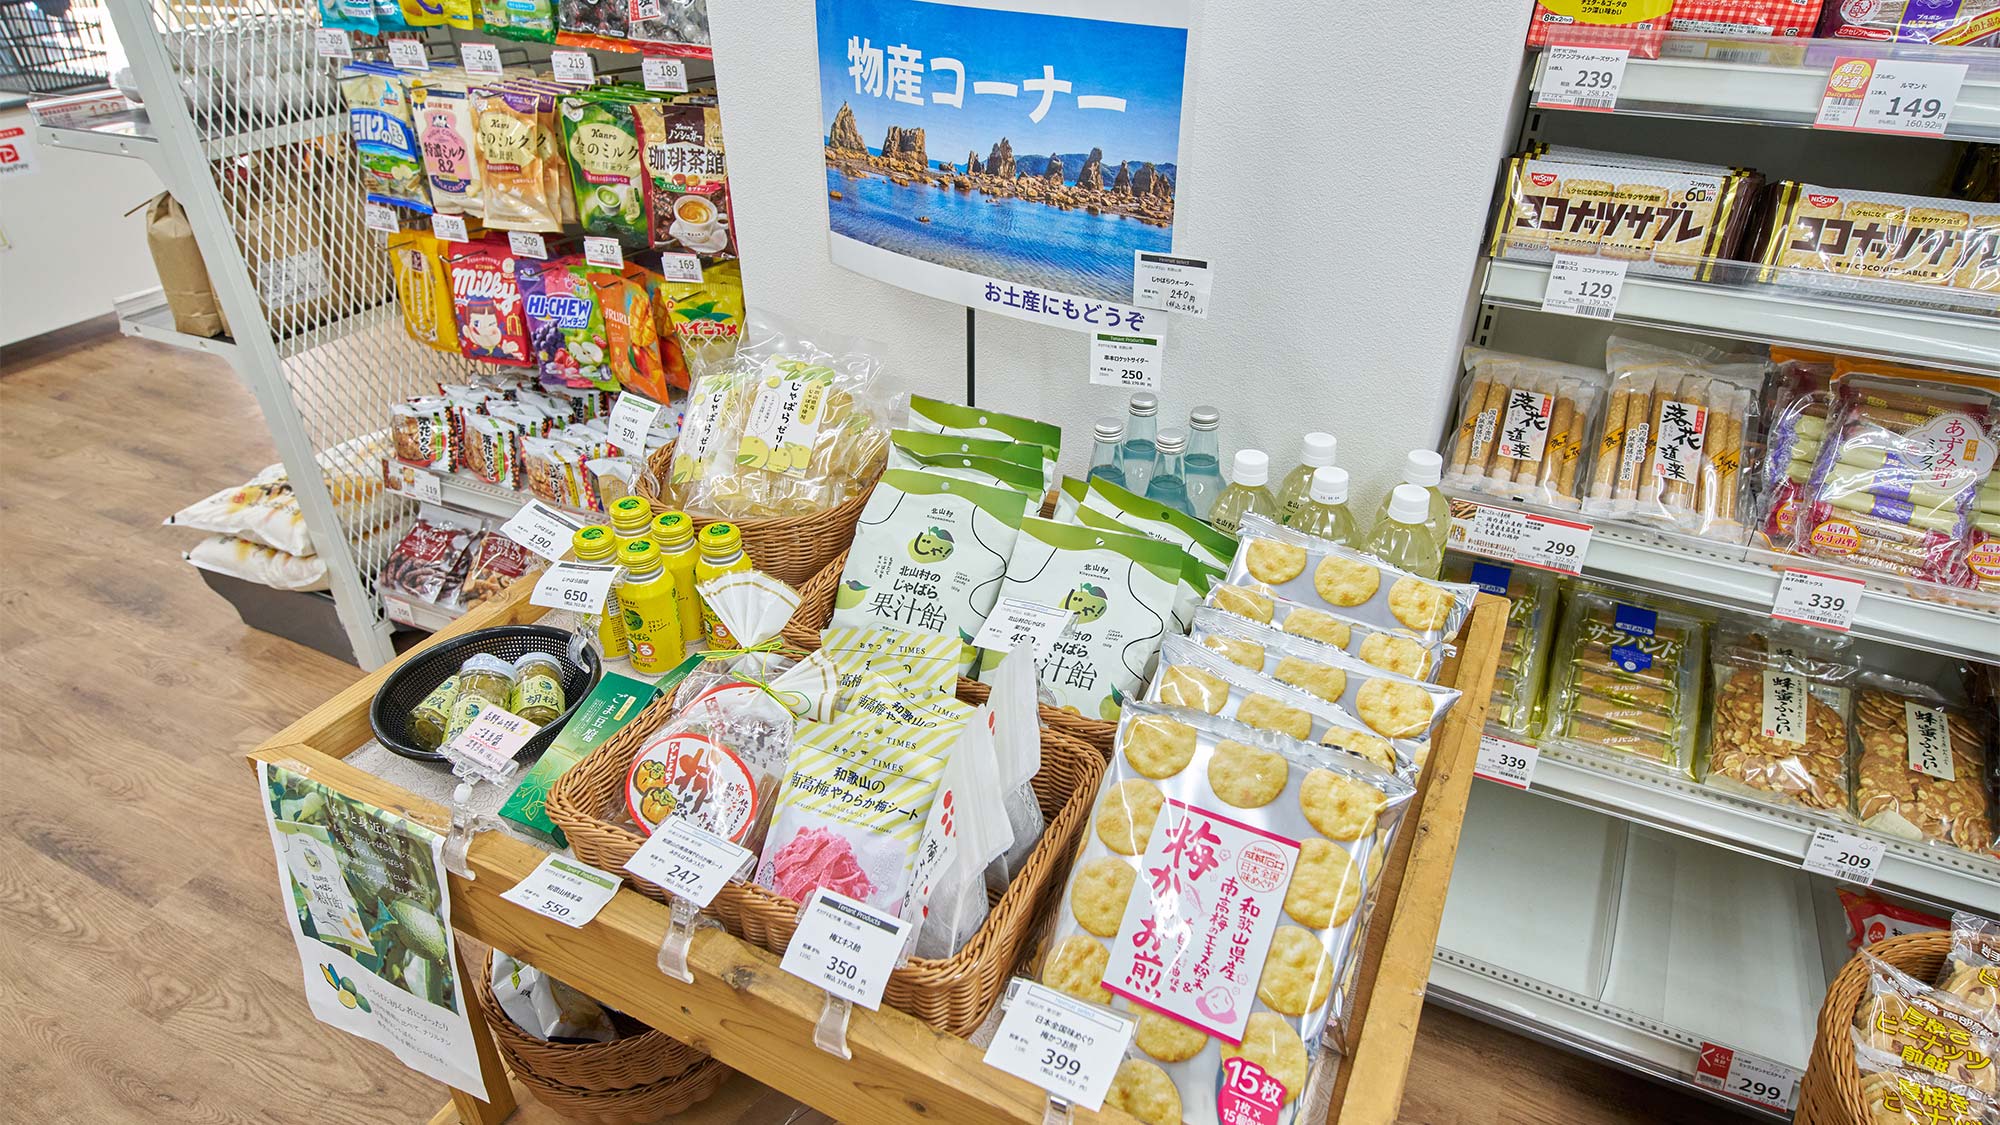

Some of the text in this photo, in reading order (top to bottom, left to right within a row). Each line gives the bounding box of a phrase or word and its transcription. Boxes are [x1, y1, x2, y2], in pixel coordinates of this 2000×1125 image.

[1581, 7, 1622, 15] コク深い味わい
[329, 34, 343, 45] 209
[403, 44, 418, 56] 219
[478, 50, 493, 61] 219
[569, 57, 585, 69] 219
[660, 65, 678, 77] 189
[847, 35, 1128, 124] 物産コーナー
[1575, 70, 1613, 89] 239
[1900, 82, 1927, 90] ルマンド
[1886, 96, 1942, 119] 149
[1937, 111, 1946, 120] 円
[591, 128, 617, 141] Kanro
[675, 123, 694, 131] Kanro
[424, 142, 466, 161] 特濃ミルク
[648, 146, 725, 175] 珈琲茶館
[1532, 174, 1556, 182] NISSIN
[1811, 196, 1836, 205] NISSIN
[378, 210, 391, 220] 209
[1516, 195, 1706, 243] ココナッツサブレ
[444, 220, 459, 231] 199
[523, 236, 538, 247] 209
[600, 245, 615, 256] 219
[678, 259, 695, 270] 169
[452, 267, 521, 316] Milky
[1578, 281, 1613, 299] 129
[984, 281, 1145, 332] お土産にもどうぞ
[675, 322, 738, 337] パインアメ
[1121, 369, 1143, 381] 250
[774, 382, 802, 452] じゃばらゼリー
[623, 428, 635, 440] 570
[931, 507, 955, 518] 北山村
[529, 533, 552, 549] 190
[1545, 540, 1576, 557] 299
[1813, 533, 1859, 548] あずみ野
[899, 565, 941, 583] 北山村の
[1084, 563, 1109, 574] 北山村
[564, 589, 588, 602] 650
[893, 578, 939, 600] じゃばら
[1808, 593, 1845, 611] 339
[866, 591, 948, 633] 果汁飴
[899, 645, 926, 655] TIMES
[1053, 641, 1089, 658] ゃばら
[1588, 624, 1683, 658] サラバンド
[1040, 653, 1098, 691] 汁飴
[932, 703, 961, 721] TIMES
[886, 736, 917, 751] TIMES
[833, 745, 904, 774] おやつ TIMES
[1499, 754, 1527, 770] 339
[833, 766, 886, 795] 和歌山の
[791, 771, 920, 822] 南高梅やわらか梅シート
[1837, 851, 1871, 869] 209
[667, 864, 700, 887] 247
[541, 899, 570, 917] 550
[838, 903, 882, 927] Tenant Products
[829, 932, 862, 953] 梅エキス飴
[1219, 896, 1260, 983] 和歌山県産
[826, 956, 858, 980] 350
[1035, 1015, 1095, 1046] 日本全国味めぐり
[1901, 1006, 1971, 1047] 厚焼き
[1039, 1030, 1078, 1053] 梅かつお煎
[1041, 1048, 1081, 1077] 399
[1228, 1060, 1283, 1107] 15枚
[1739, 1078, 1780, 1100] 299
[1899, 1077, 1970, 1115] 厚焼き
